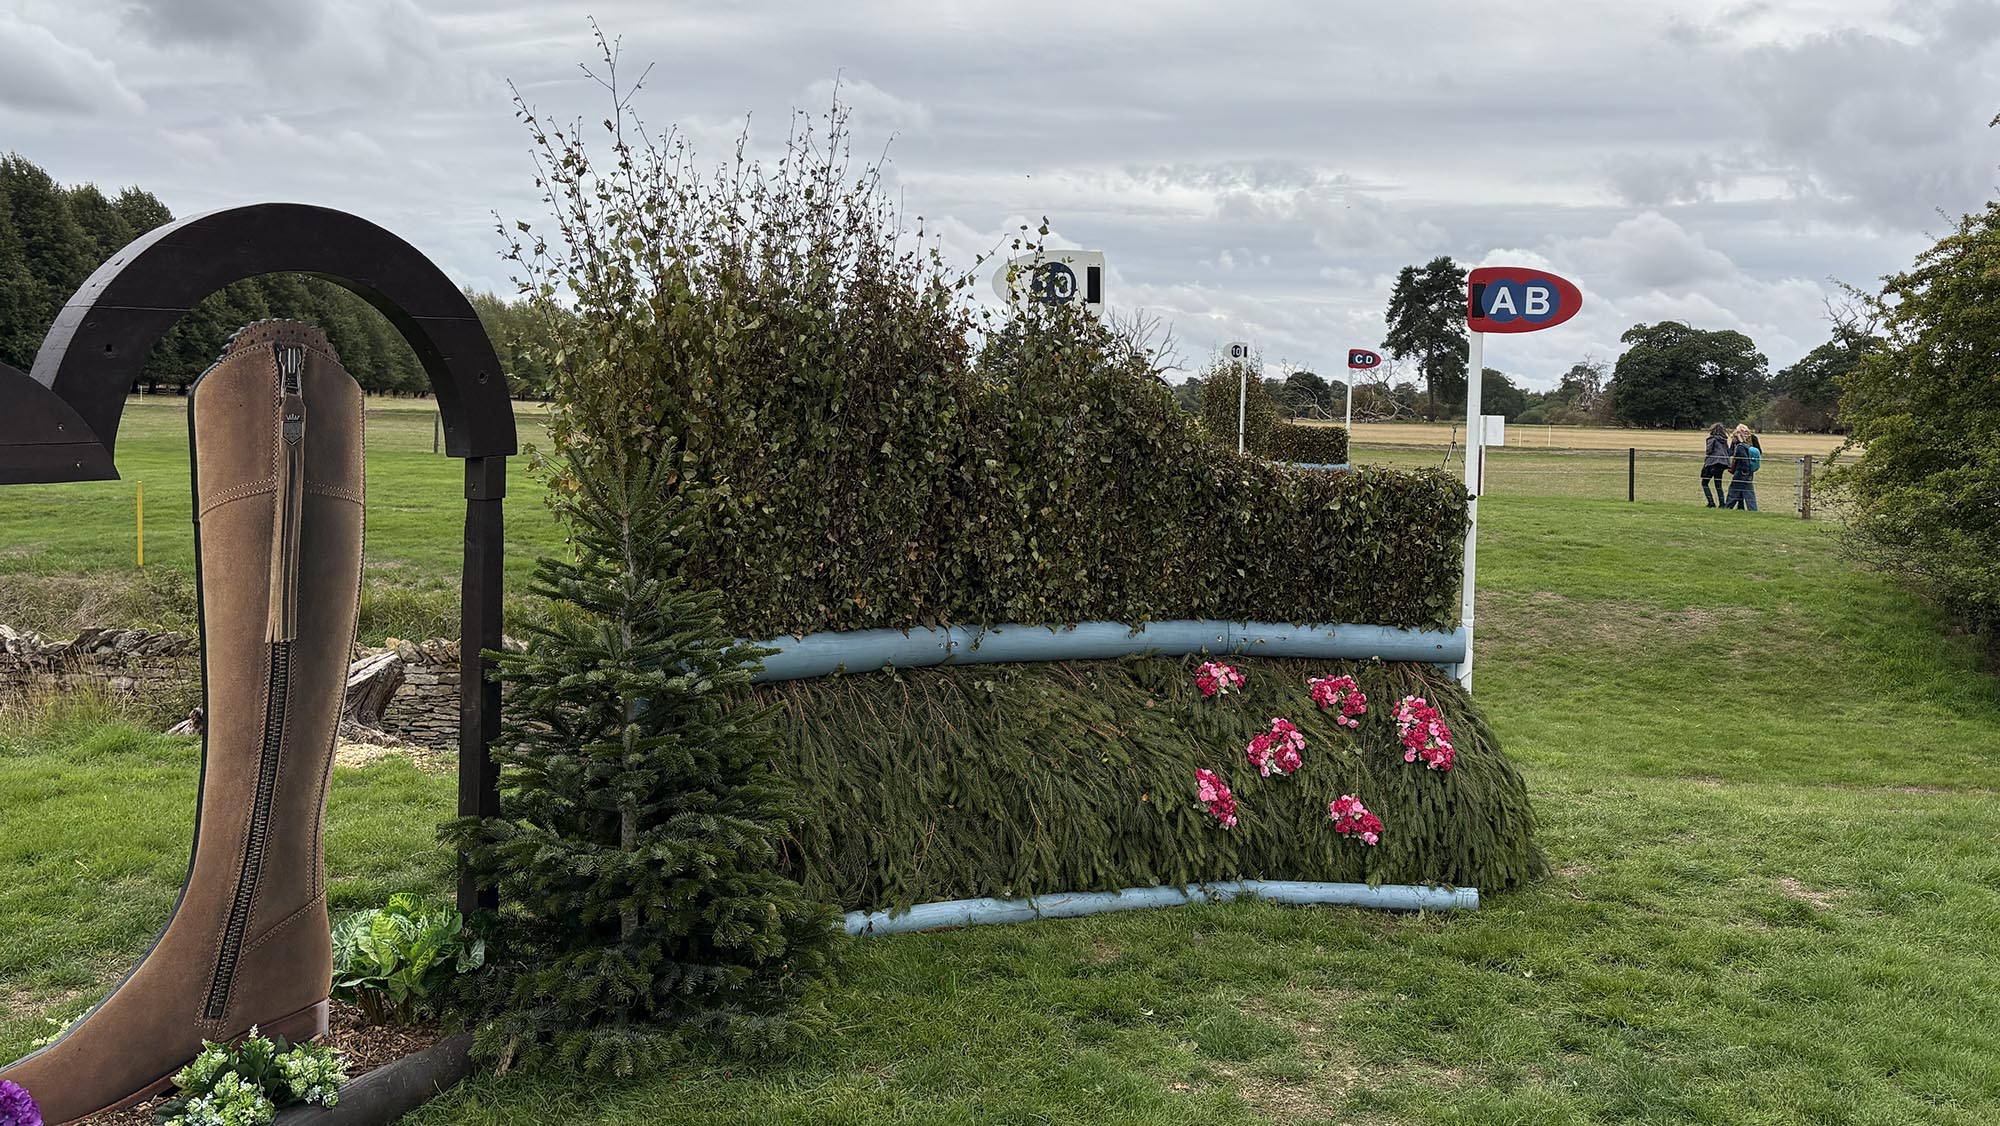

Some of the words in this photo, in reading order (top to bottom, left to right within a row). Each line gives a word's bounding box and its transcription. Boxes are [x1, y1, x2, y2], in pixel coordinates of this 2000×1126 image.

[1489, 286, 1550, 315] AB
[1232, 347, 1241, 356] 10
[1355, 354, 1373, 364] CD
